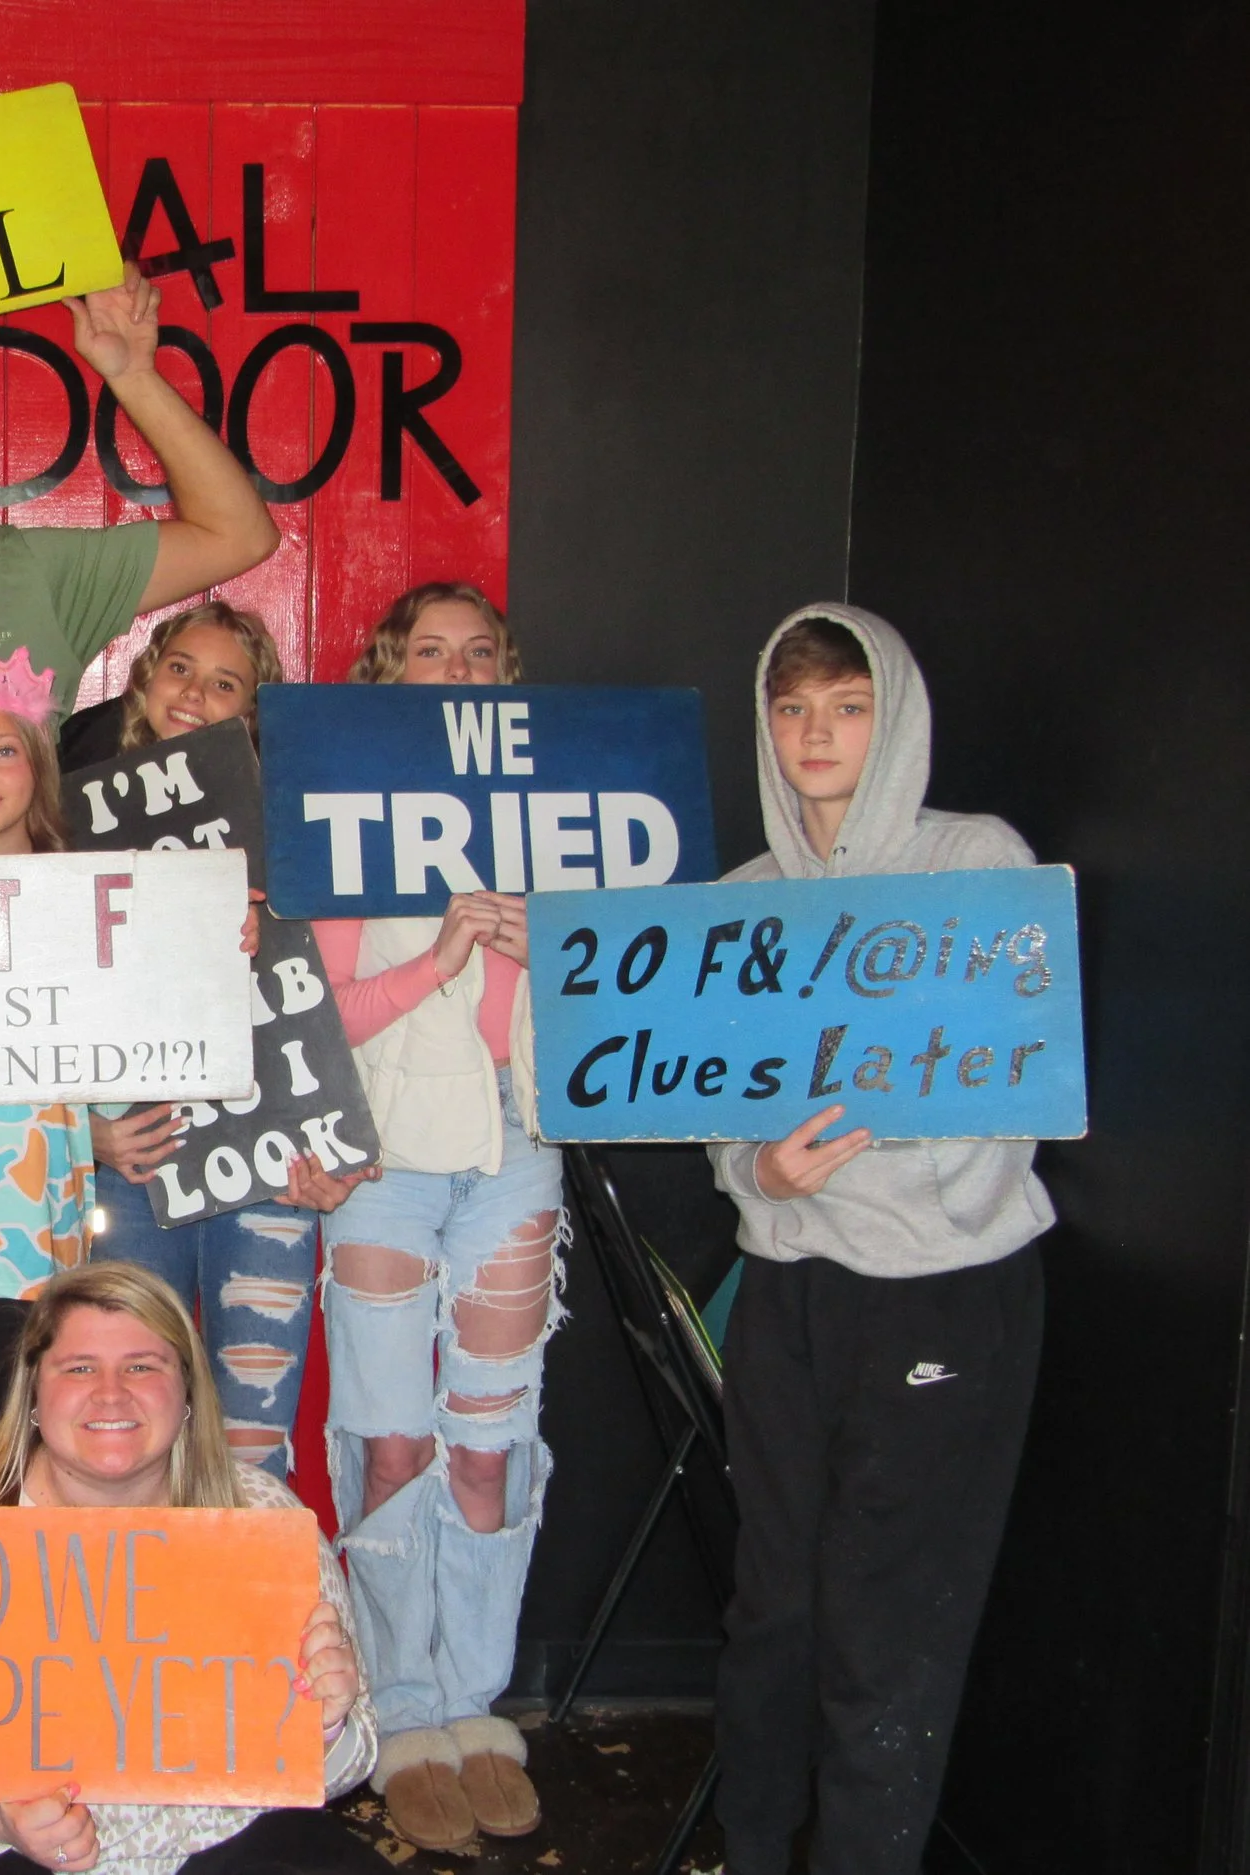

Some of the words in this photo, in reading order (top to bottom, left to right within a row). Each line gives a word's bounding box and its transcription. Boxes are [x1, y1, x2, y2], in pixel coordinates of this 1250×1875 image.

[442, 701, 534, 775] WE
[82, 751, 204, 834] I'M
[303, 792, 679, 895] TRIED
[560, 925, 668, 996] 20
[281, 1040, 320, 1097] I
[566, 1028, 788, 1108] Clues
[807, 1024, 1046, 1099] Later
[156, 1110, 368, 1219] LOOK
[914, 1362, 945, 1378] NIKE
[35, 1529, 168, 1643] WE
[99, 1656, 298, 1774] YET?
